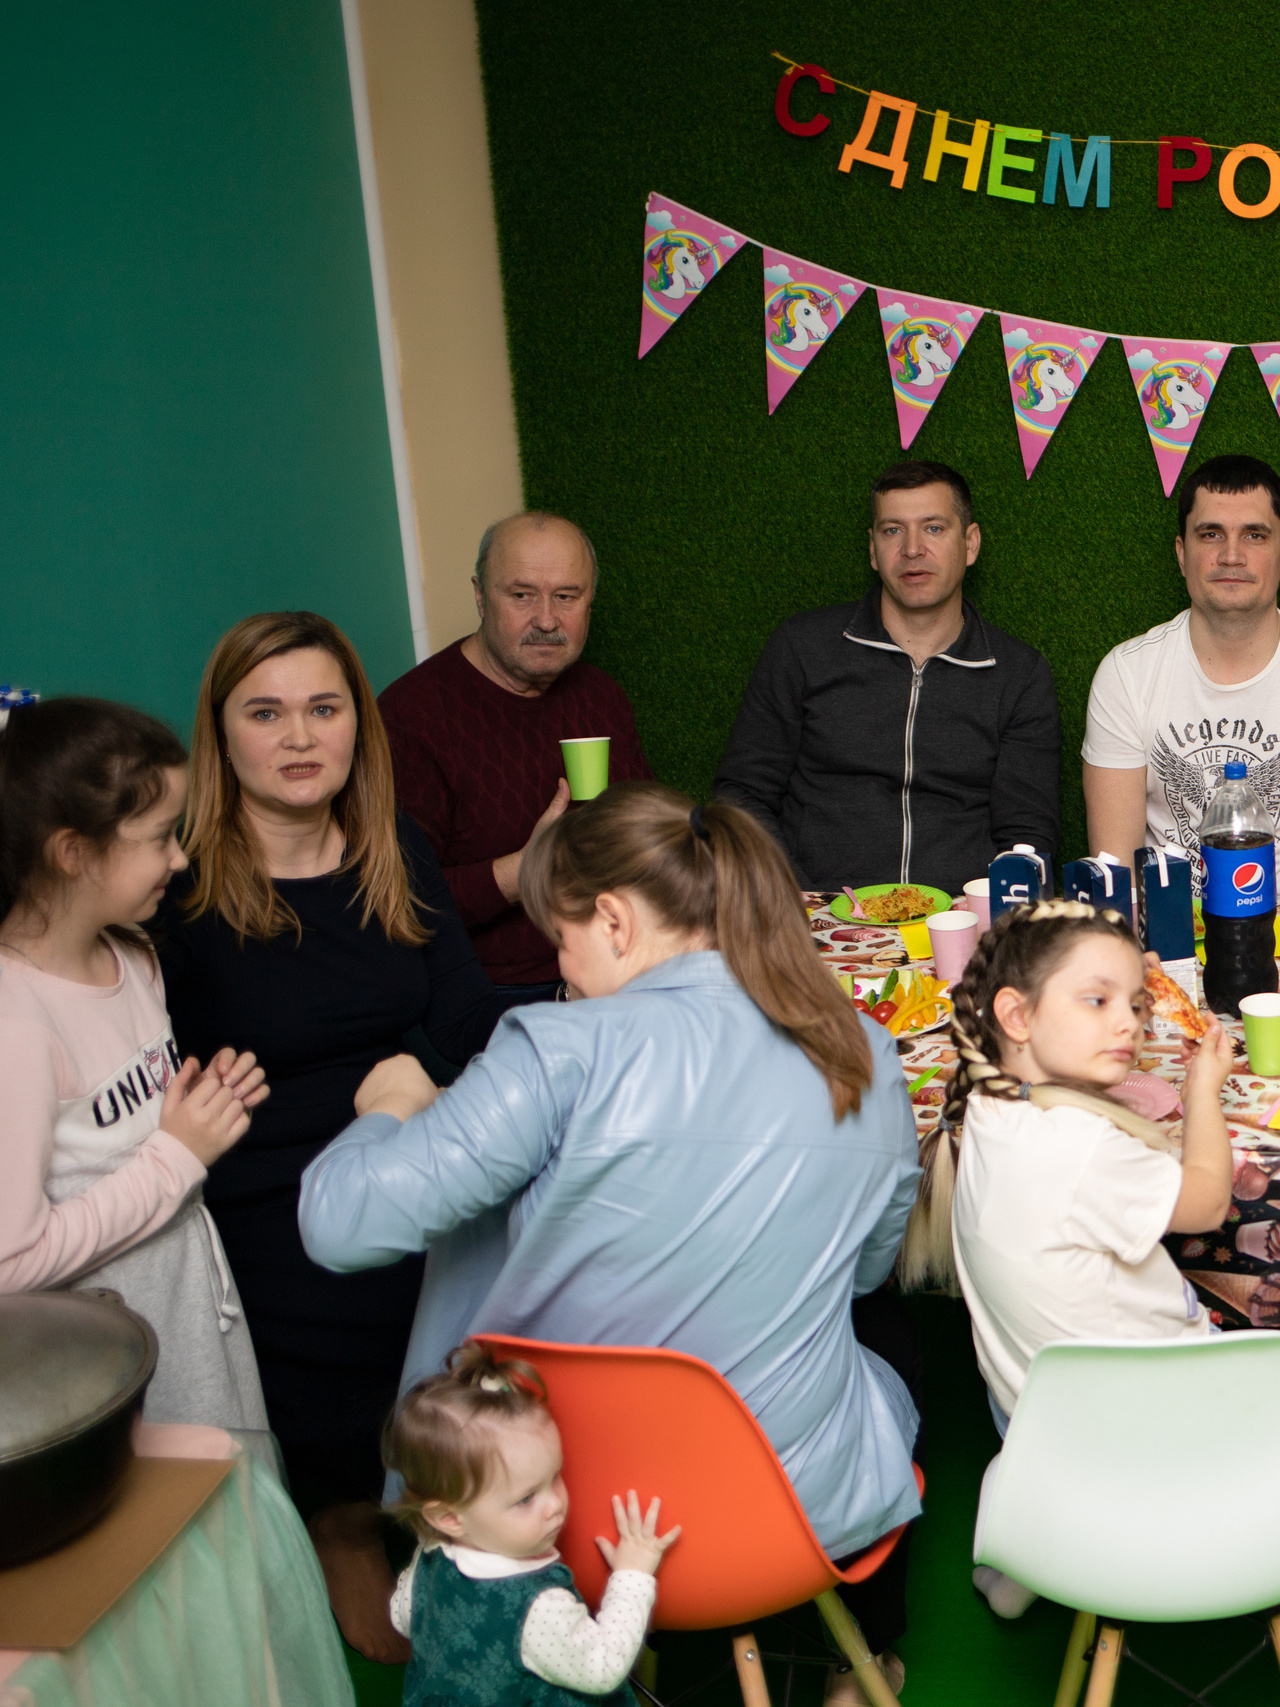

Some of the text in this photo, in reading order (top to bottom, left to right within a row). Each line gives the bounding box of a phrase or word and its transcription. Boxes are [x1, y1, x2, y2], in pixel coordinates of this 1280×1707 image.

[774, 63, 835, 136] С
[838, 90, 1111, 208] ДНЕМ
[1168, 717, 1280, 752] legends
[1195, 749, 1255, 767] LIVE FAST
[1168, 787, 1201, 851] MOTORCYCL
[1236, 894, 1263, 907] pepsi
